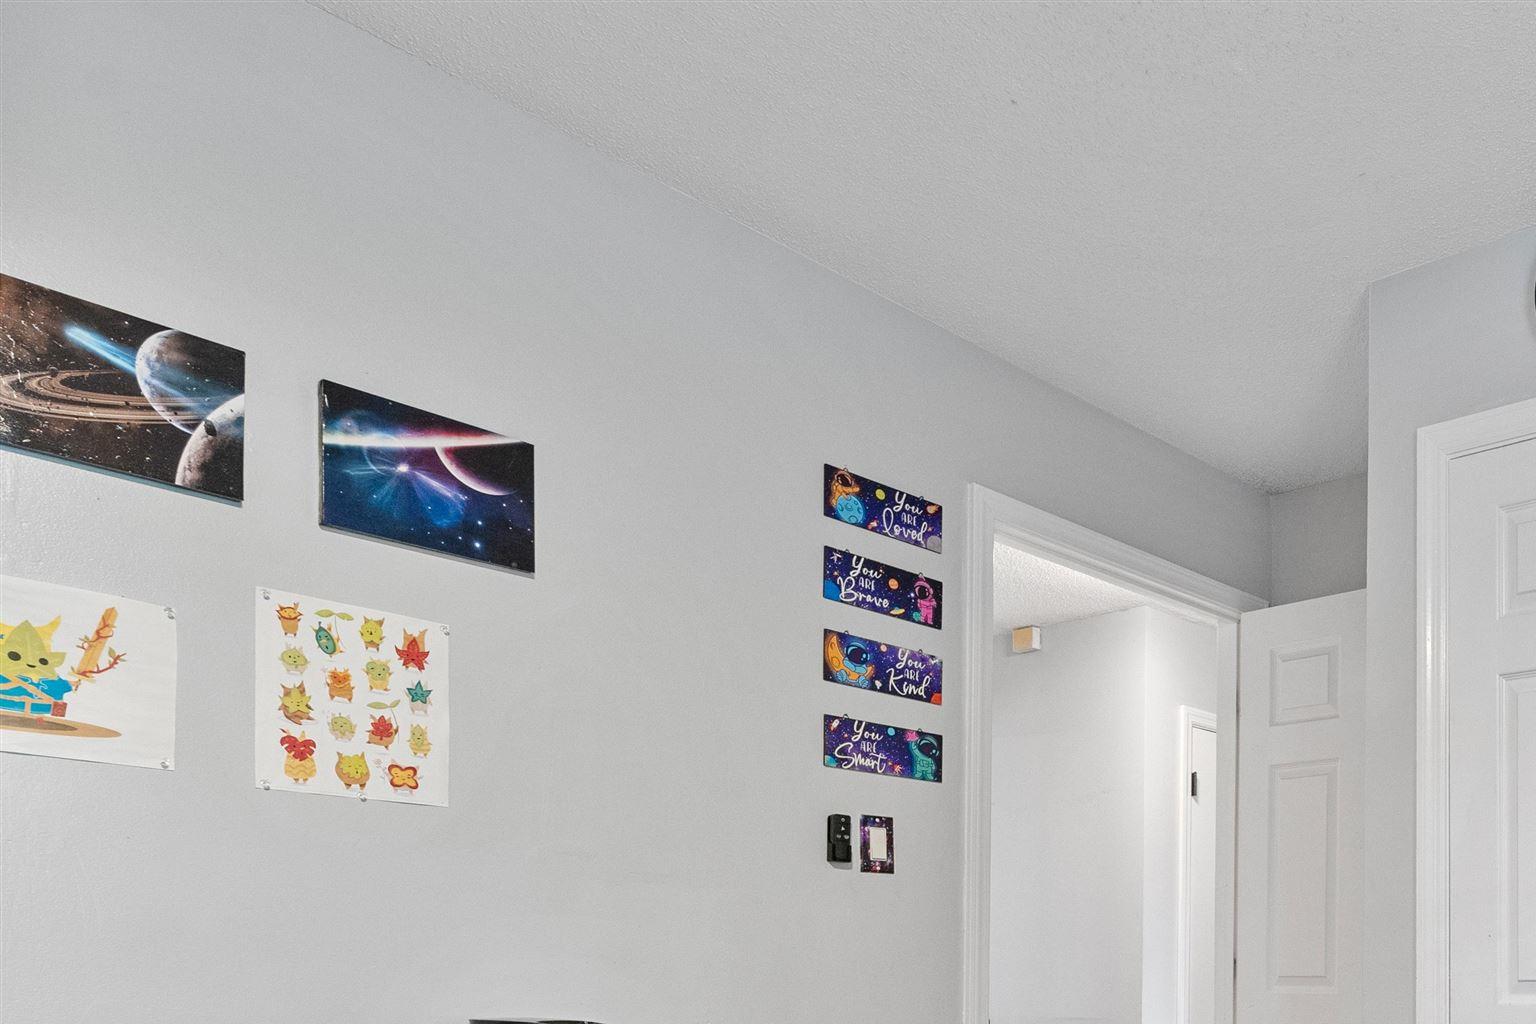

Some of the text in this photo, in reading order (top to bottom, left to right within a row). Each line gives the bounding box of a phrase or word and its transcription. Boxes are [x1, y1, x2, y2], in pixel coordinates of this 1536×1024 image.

[893, 490, 923, 517] You
[882, 507, 928, 548] loved
[900, 512, 917, 527] ARE
[850, 555, 882, 579] You
[837, 575, 889, 608] Brave
[858, 576, 876, 591] ARE
[896, 648, 926, 670] You
[886, 668, 930, 698] Kind
[904, 667, 920, 682] ARE
[851, 719, 883, 743] You
[835, 742, 887, 773] Smart
[859, 740, 877, 754] ARE
